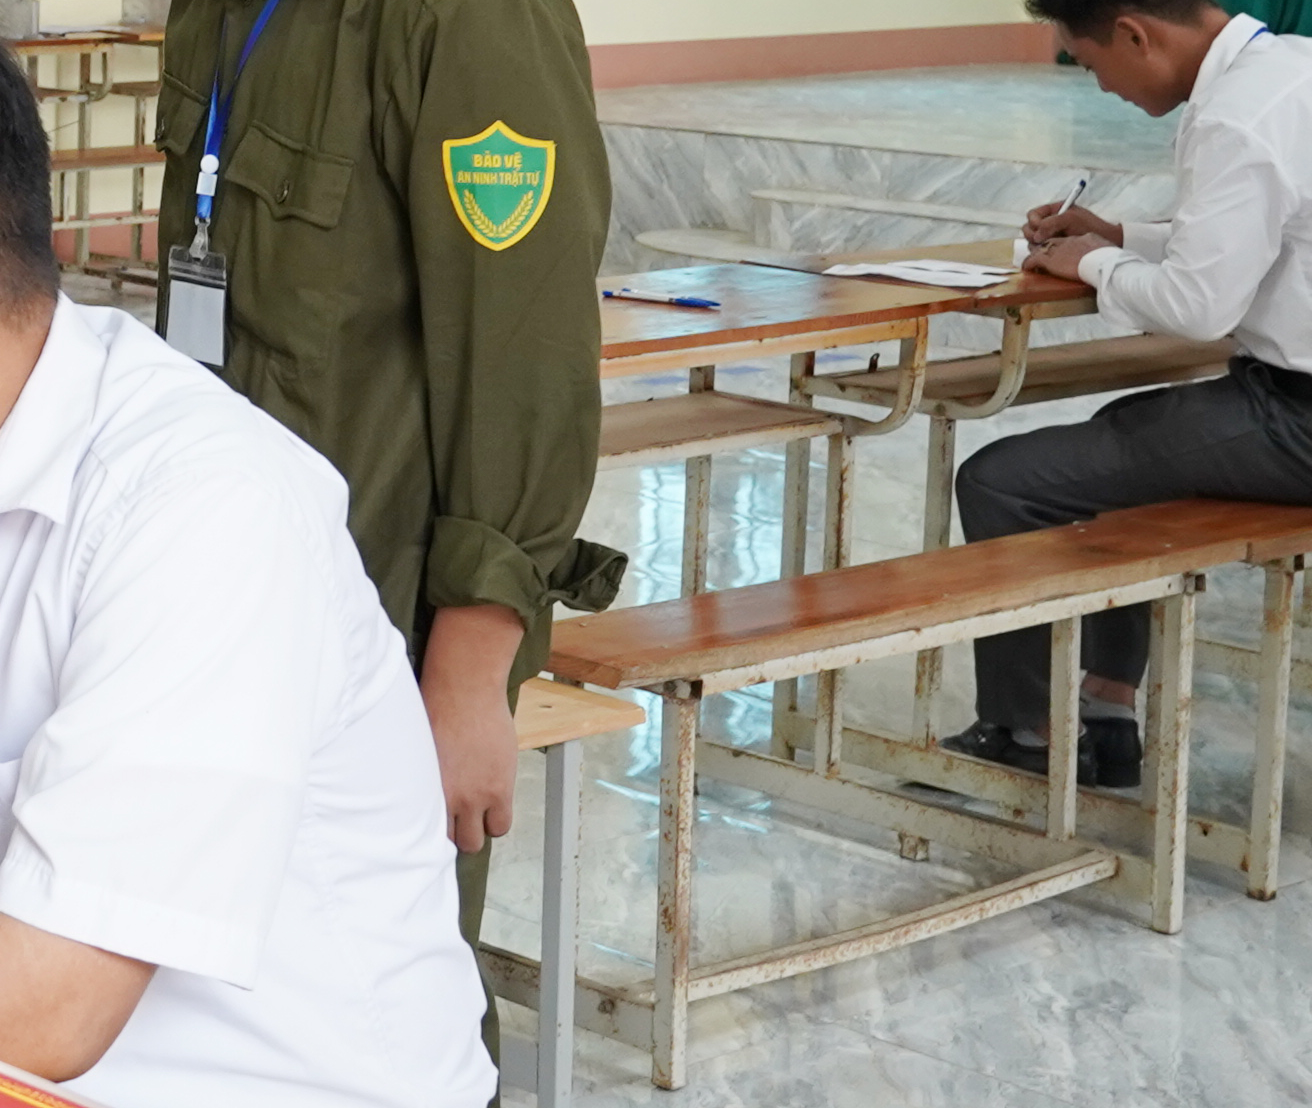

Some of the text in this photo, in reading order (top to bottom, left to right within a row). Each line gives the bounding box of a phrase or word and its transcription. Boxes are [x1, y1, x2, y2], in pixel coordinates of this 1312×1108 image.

[473, 150, 522, 169] BẢO VỆ
[457, 168, 540, 187] AN NINH TRẬT TỰ
